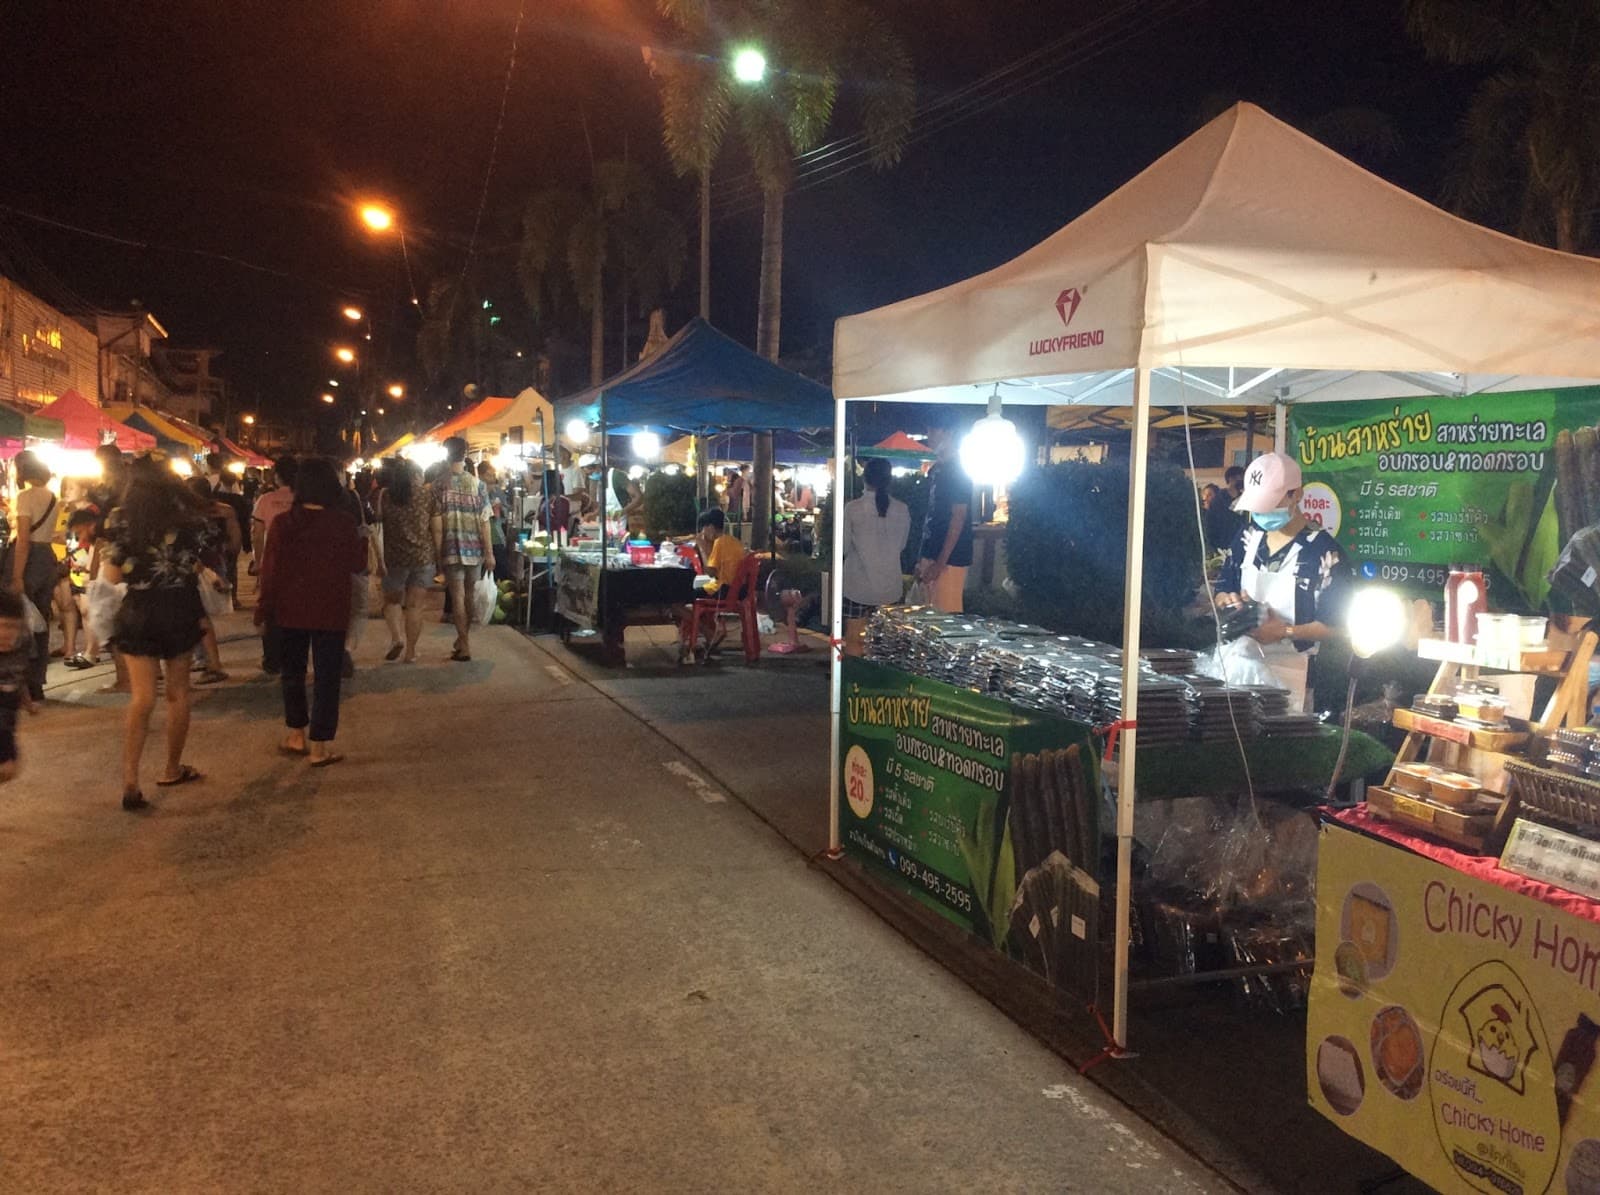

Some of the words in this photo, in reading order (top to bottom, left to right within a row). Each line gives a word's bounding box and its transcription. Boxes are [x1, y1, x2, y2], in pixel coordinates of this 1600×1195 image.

[1029, 330, 1104, 356] LUCKYFRIEND
[1299, 405, 1432, 465] บ้านสาหร่าย
[1437, 416, 1546, 442] สาหร่ายทะเล
[1360, 480, 1372, 496] มี
[1374, 483, 1385, 496] 5
[1388, 482, 1439, 497] รสชาติ
[847, 682, 931, 728] บ้านสาหร่าย
[931, 715, 1004, 757] สาหร่ายทะเล
[894, 763, 902, 777] 5
[899, 855, 972, 912] 099-495-2595
[1424, 880, 1522, 948] Chicky
[1441, 1102, 1495, 1136] Chicky
[1499, 1119, 1545, 1152] Home
